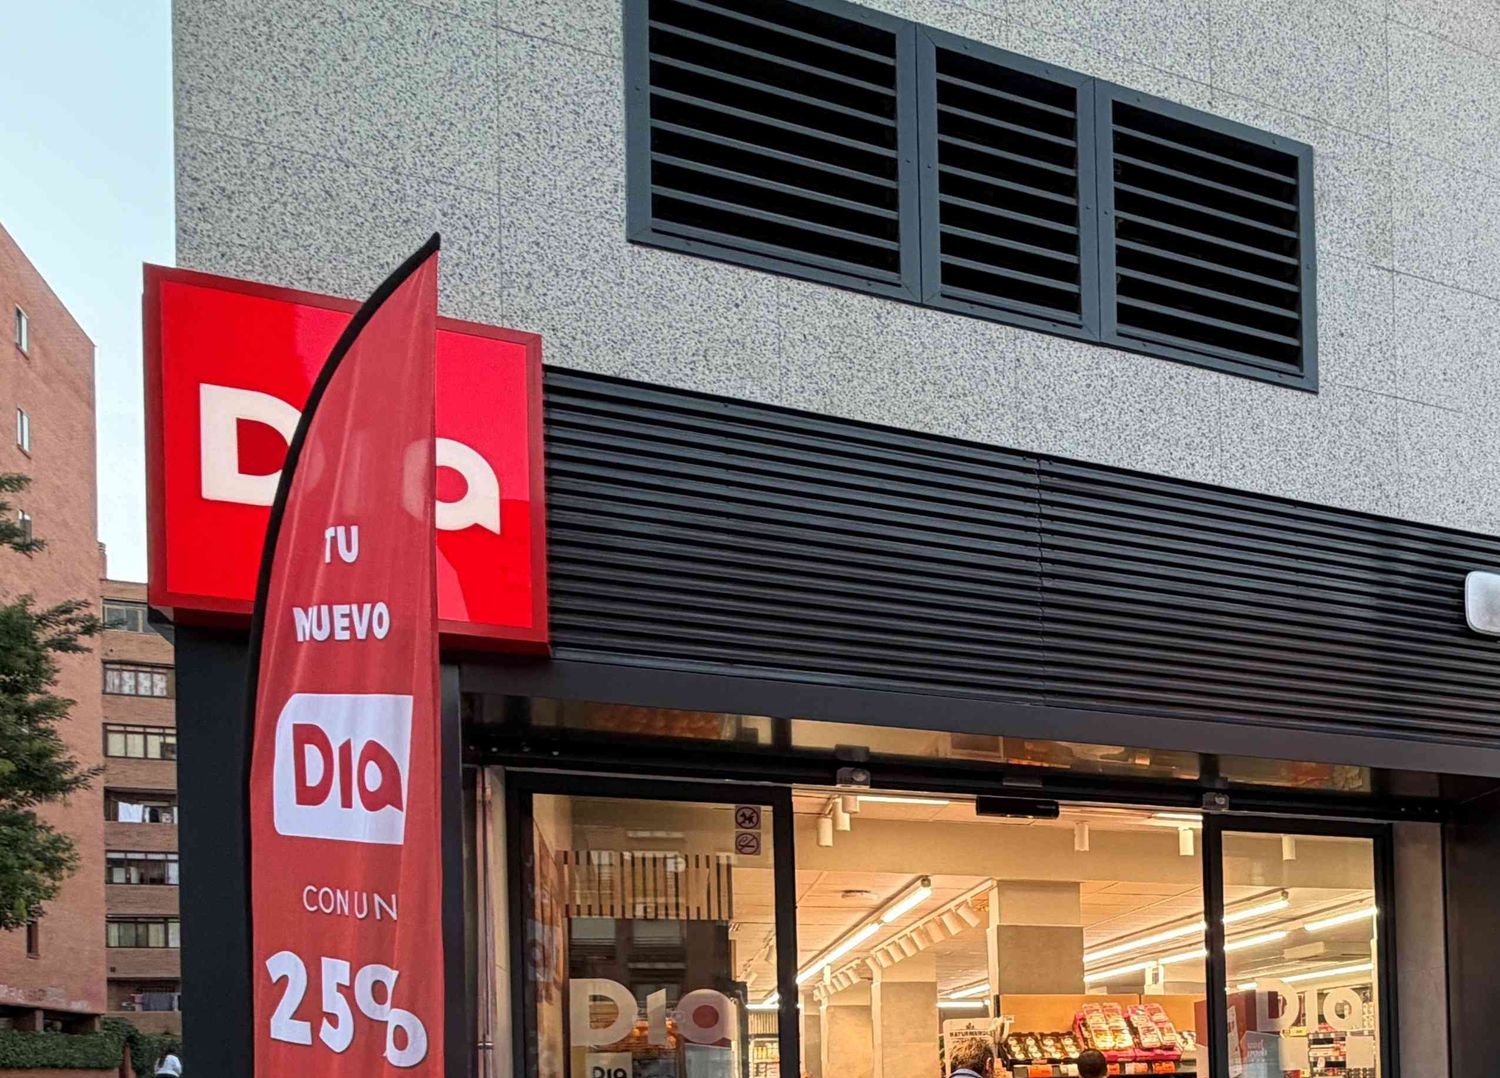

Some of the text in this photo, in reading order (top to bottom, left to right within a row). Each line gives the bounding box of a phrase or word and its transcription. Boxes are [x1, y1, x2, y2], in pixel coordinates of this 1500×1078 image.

[325, 525, 359, 564] TU
[293, 602, 390, 642] NUEVO
[303, 885, 398, 921] CON UN
[265, 951, 428, 1067] 25%
